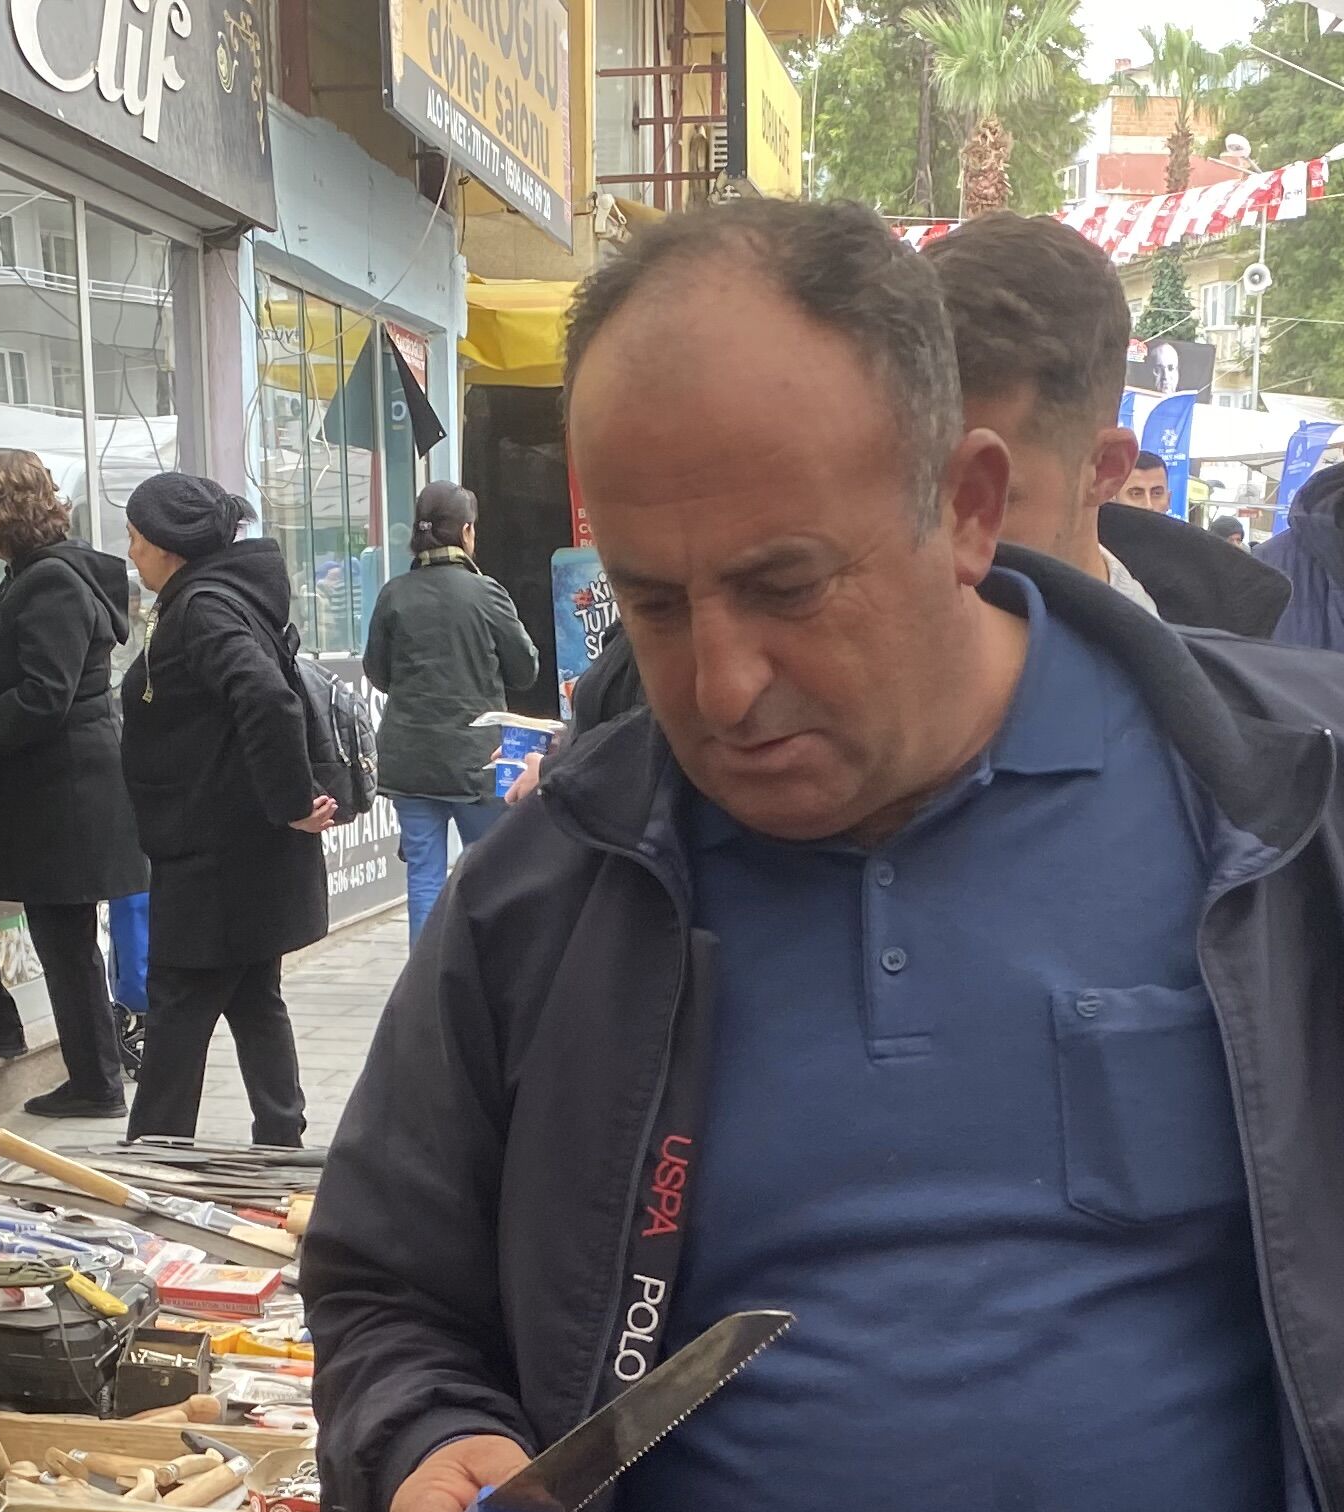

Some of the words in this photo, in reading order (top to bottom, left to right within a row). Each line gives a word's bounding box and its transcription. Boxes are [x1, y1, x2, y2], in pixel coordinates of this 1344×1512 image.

[427, 87, 442, 129] ALO
[505, 155, 521, 196] 0506
[522, 174, 534, 206] 445
[428, 7, 489, 120] döner
[496, 75, 550, 178] salonu
[328, 869, 348, 897] 0506
[350, 863, 364, 890] 445
[366, 860, 376, 884] 89
[377, 856, 387, 879] 28
[641, 1135, 692, 1237] USPA
[614, 1273, 666, 1381] POLO
